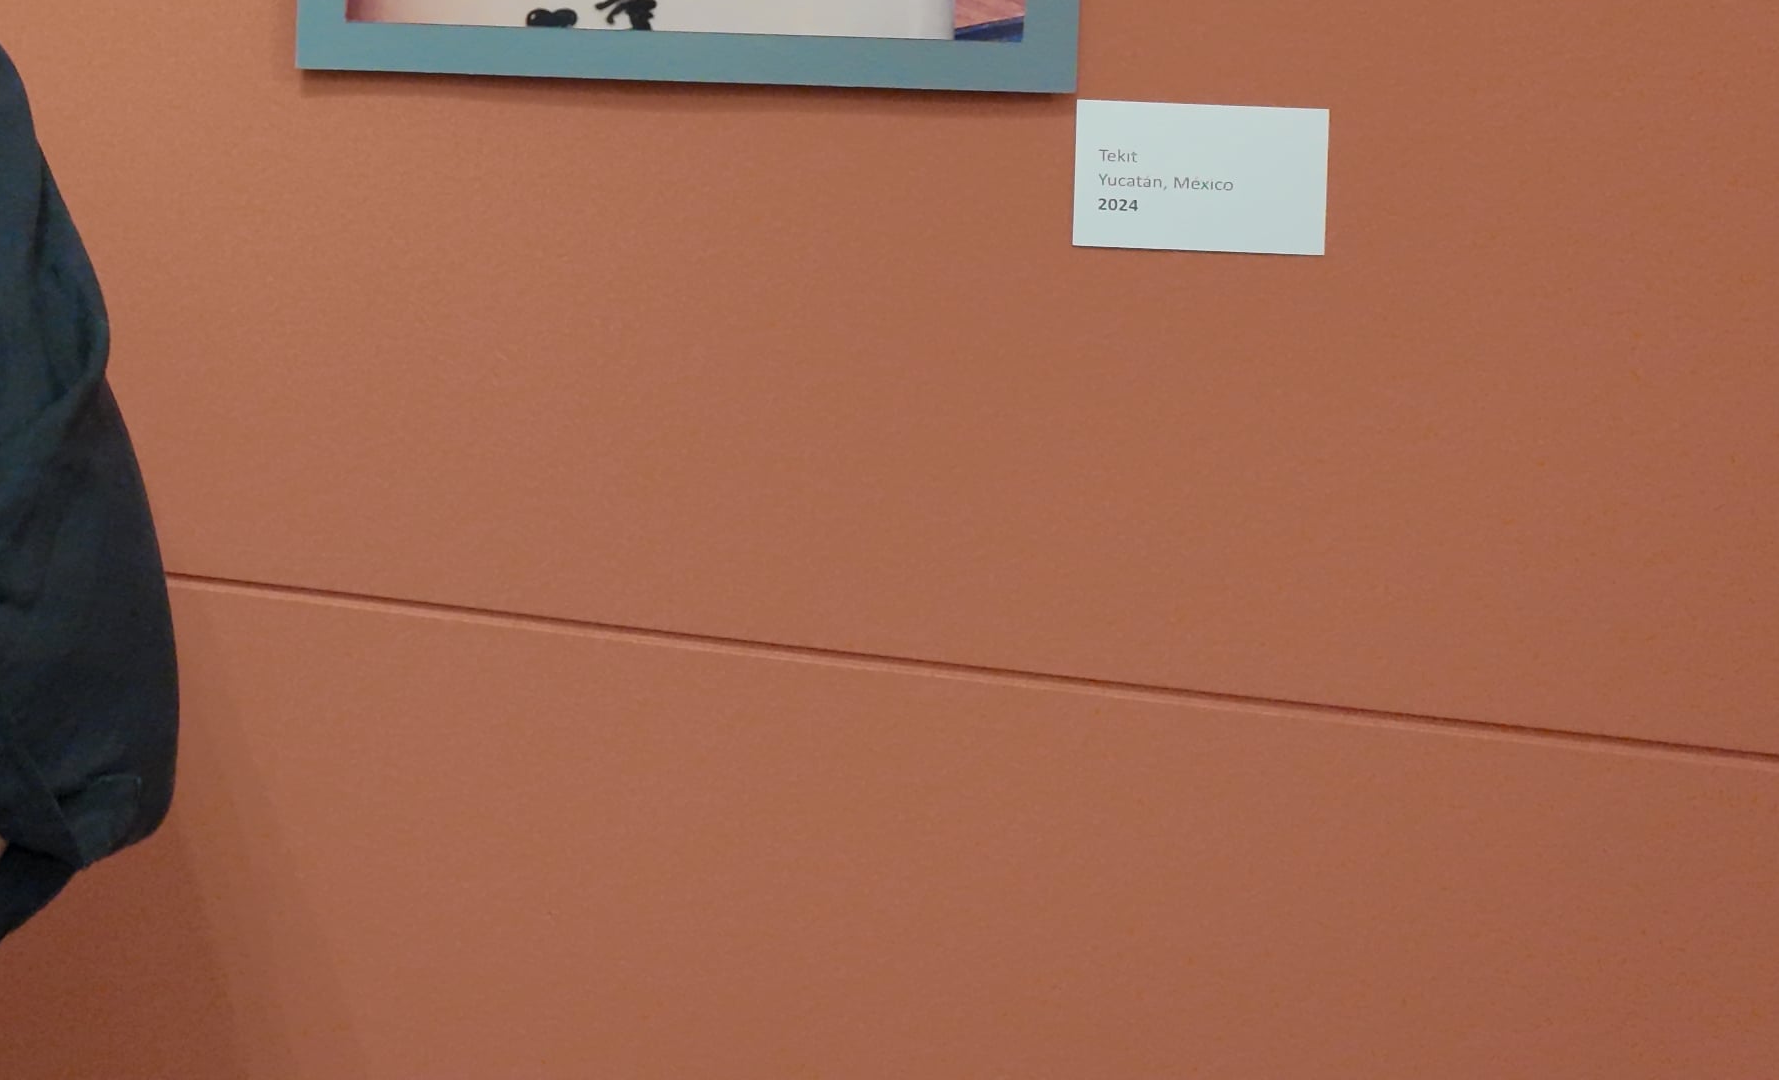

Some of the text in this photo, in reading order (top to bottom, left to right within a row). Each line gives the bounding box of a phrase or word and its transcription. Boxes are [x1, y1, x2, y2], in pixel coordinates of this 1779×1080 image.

[1098, 148, 1138, 163] Tekit
[1098, 173, 1234, 191] Yucatán, México
[1098, 198, 1139, 212] 2024
